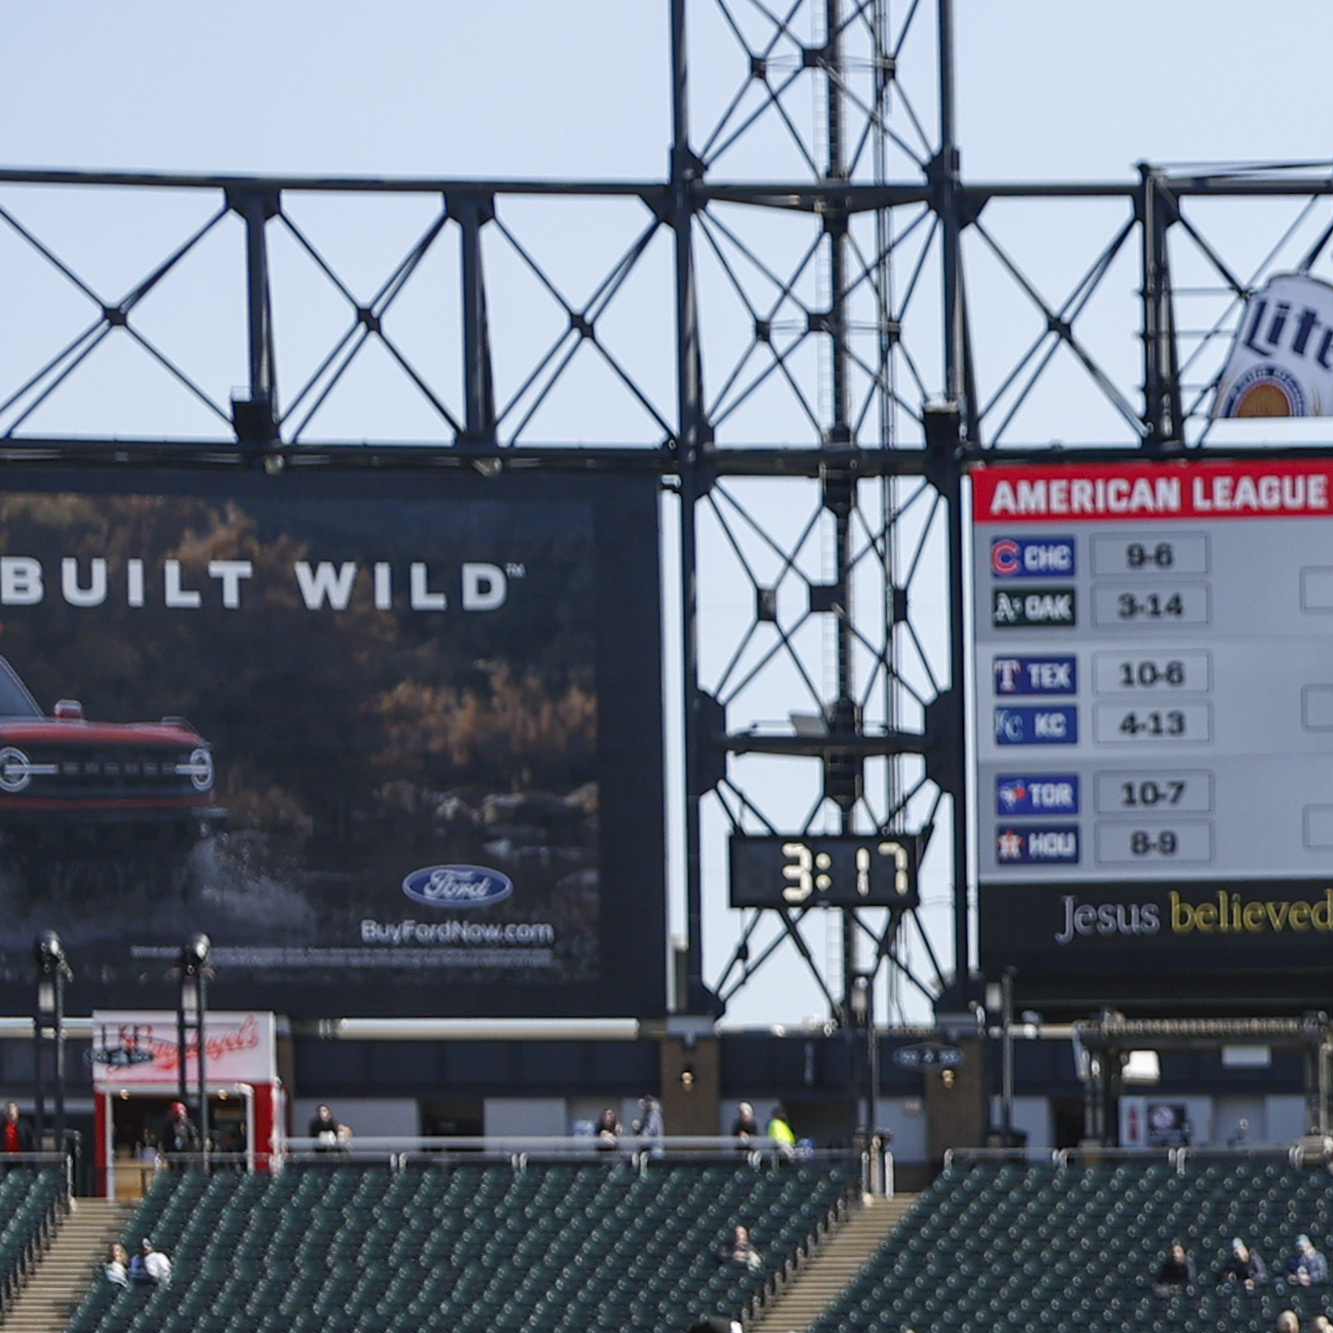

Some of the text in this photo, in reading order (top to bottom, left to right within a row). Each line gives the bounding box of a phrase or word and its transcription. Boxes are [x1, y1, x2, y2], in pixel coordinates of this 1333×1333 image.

[990, 474, 1329, 515] AMERICAN LEAGUE
[1024, 545, 1071, 571] CHC
[1127, 543, 1173, 568] 9-6
[0, 556, 252, 609] BUILT
[1025, 595, 1072, 620] OAK
[1119, 593, 1183, 618] 3-14
[1027, 663, 1071, 688] TEX
[1120, 661, 1184, 686] 10-6
[1034, 713, 1067, 737] KC
[1120, 711, 1185, 736] 4-13
[1029, 781, 1185, 808] TOR 10-7
[1029, 833, 1076, 858] HOU
[1131, 831, 1177, 855] 8-9
[423, 869, 492, 899] Ford
[782, 841, 908, 903] 3:17
[361, 919, 554, 945] BuyFordNow.com
[1055, 895, 1160, 944] Jesus
